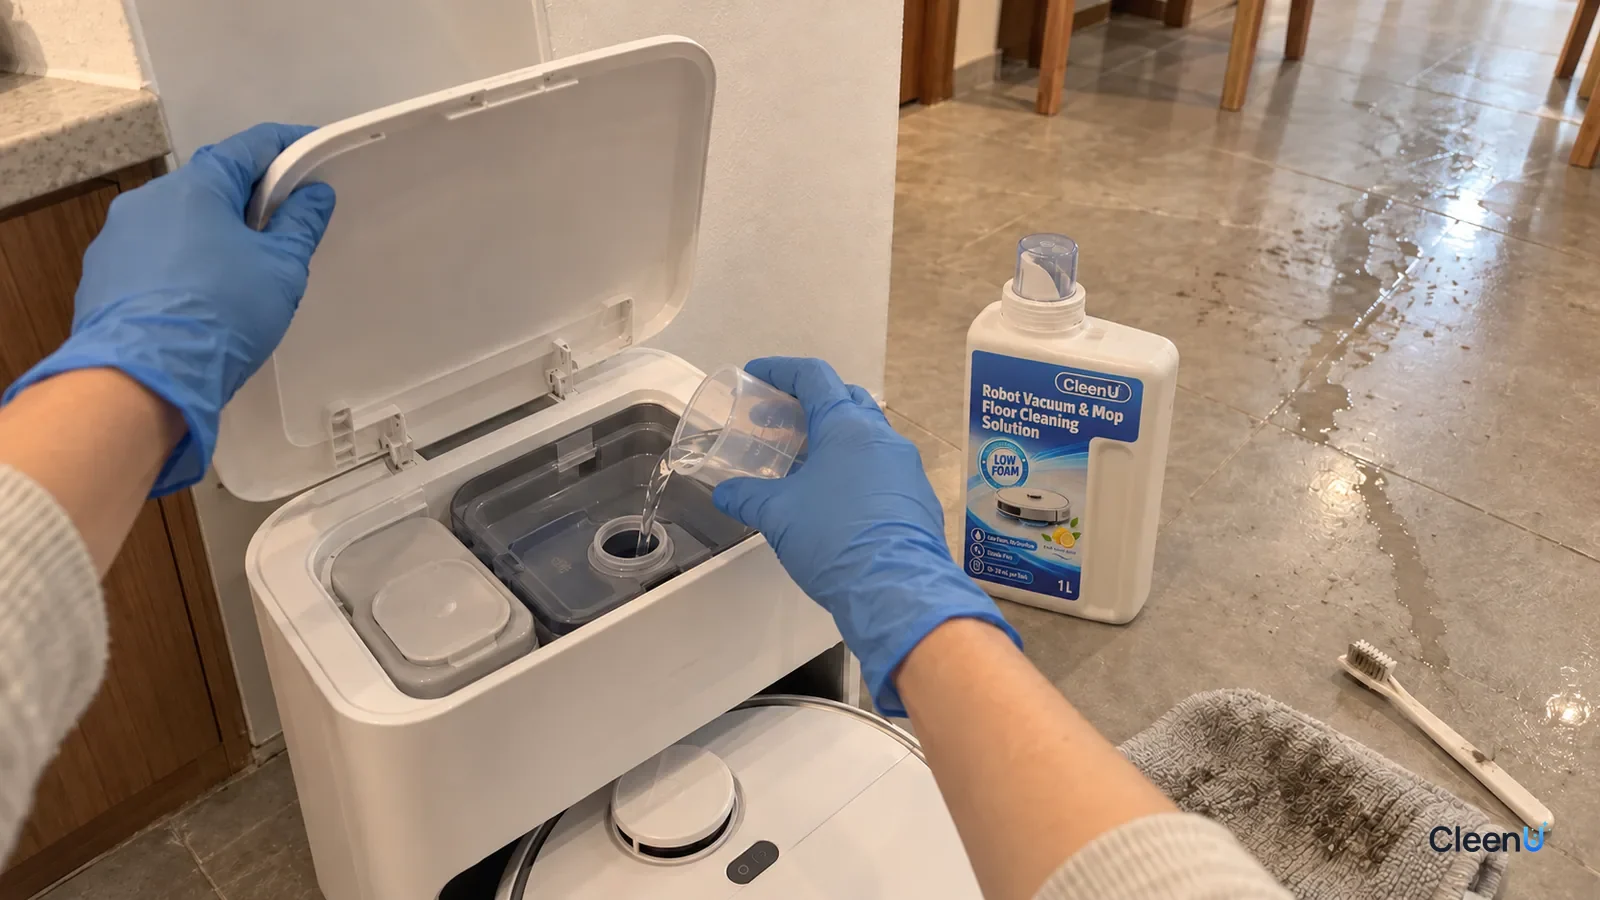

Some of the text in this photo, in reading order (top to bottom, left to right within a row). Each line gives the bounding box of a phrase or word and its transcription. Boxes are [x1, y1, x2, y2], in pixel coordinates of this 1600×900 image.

[1063, 378, 1120, 398] CleenU
[982, 384, 1124, 425] Robot Vacuum & Mop
[982, 400, 1079, 434] Floor Cleaning
[982, 415, 1040, 439] Solution
[994, 454, 1016, 465] LOW
[991, 466, 1019, 476] FOAM
[1058, 579, 1072, 594] 1L
